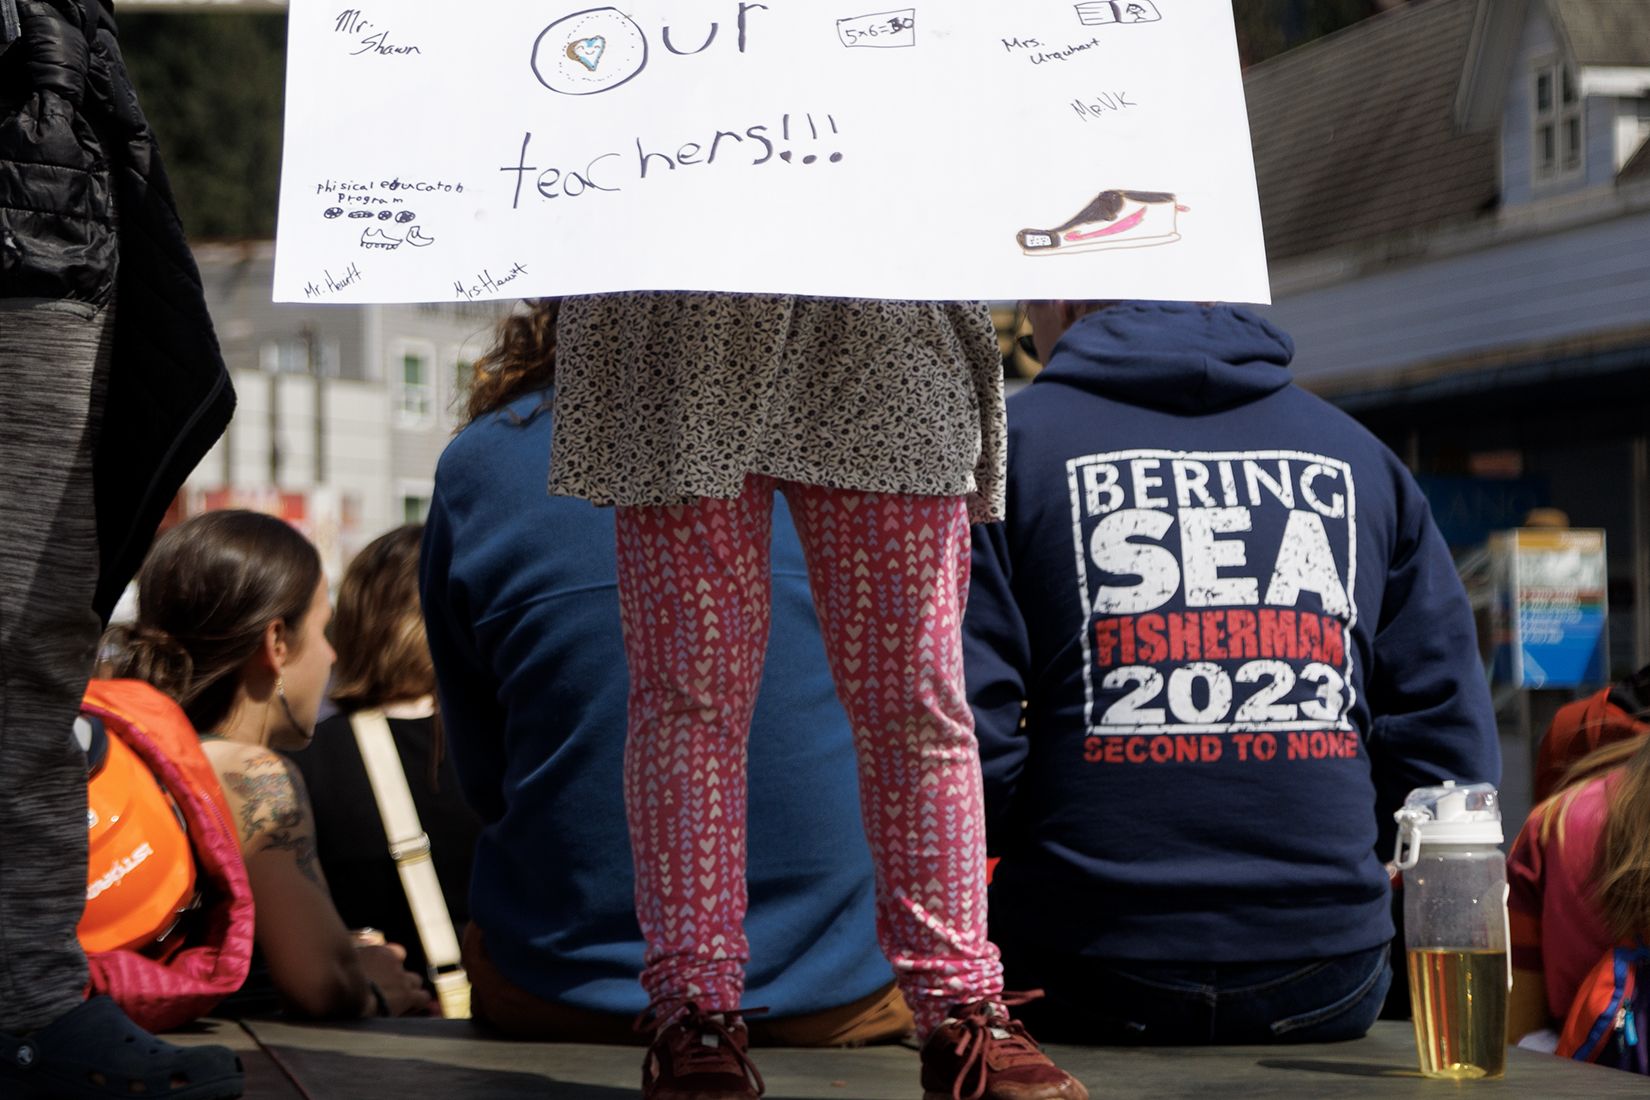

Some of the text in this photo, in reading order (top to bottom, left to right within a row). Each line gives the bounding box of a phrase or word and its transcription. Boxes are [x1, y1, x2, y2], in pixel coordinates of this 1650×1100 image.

[349, 30, 422, 56] Shawn
[530, 2, 770, 96] Our
[1001, 37, 1045, 53] Mrs.
[500, 113, 844, 210] teachers!!!
[1082, 458, 1346, 518] BERING
[1090, 505, 1351, 619] SEA
[1094, 608, 1344, 667] FISHERMAN
[1100, 659, 1346, 726] 2023
[1082, 731, 1359, 764] SECOND TO NONE
